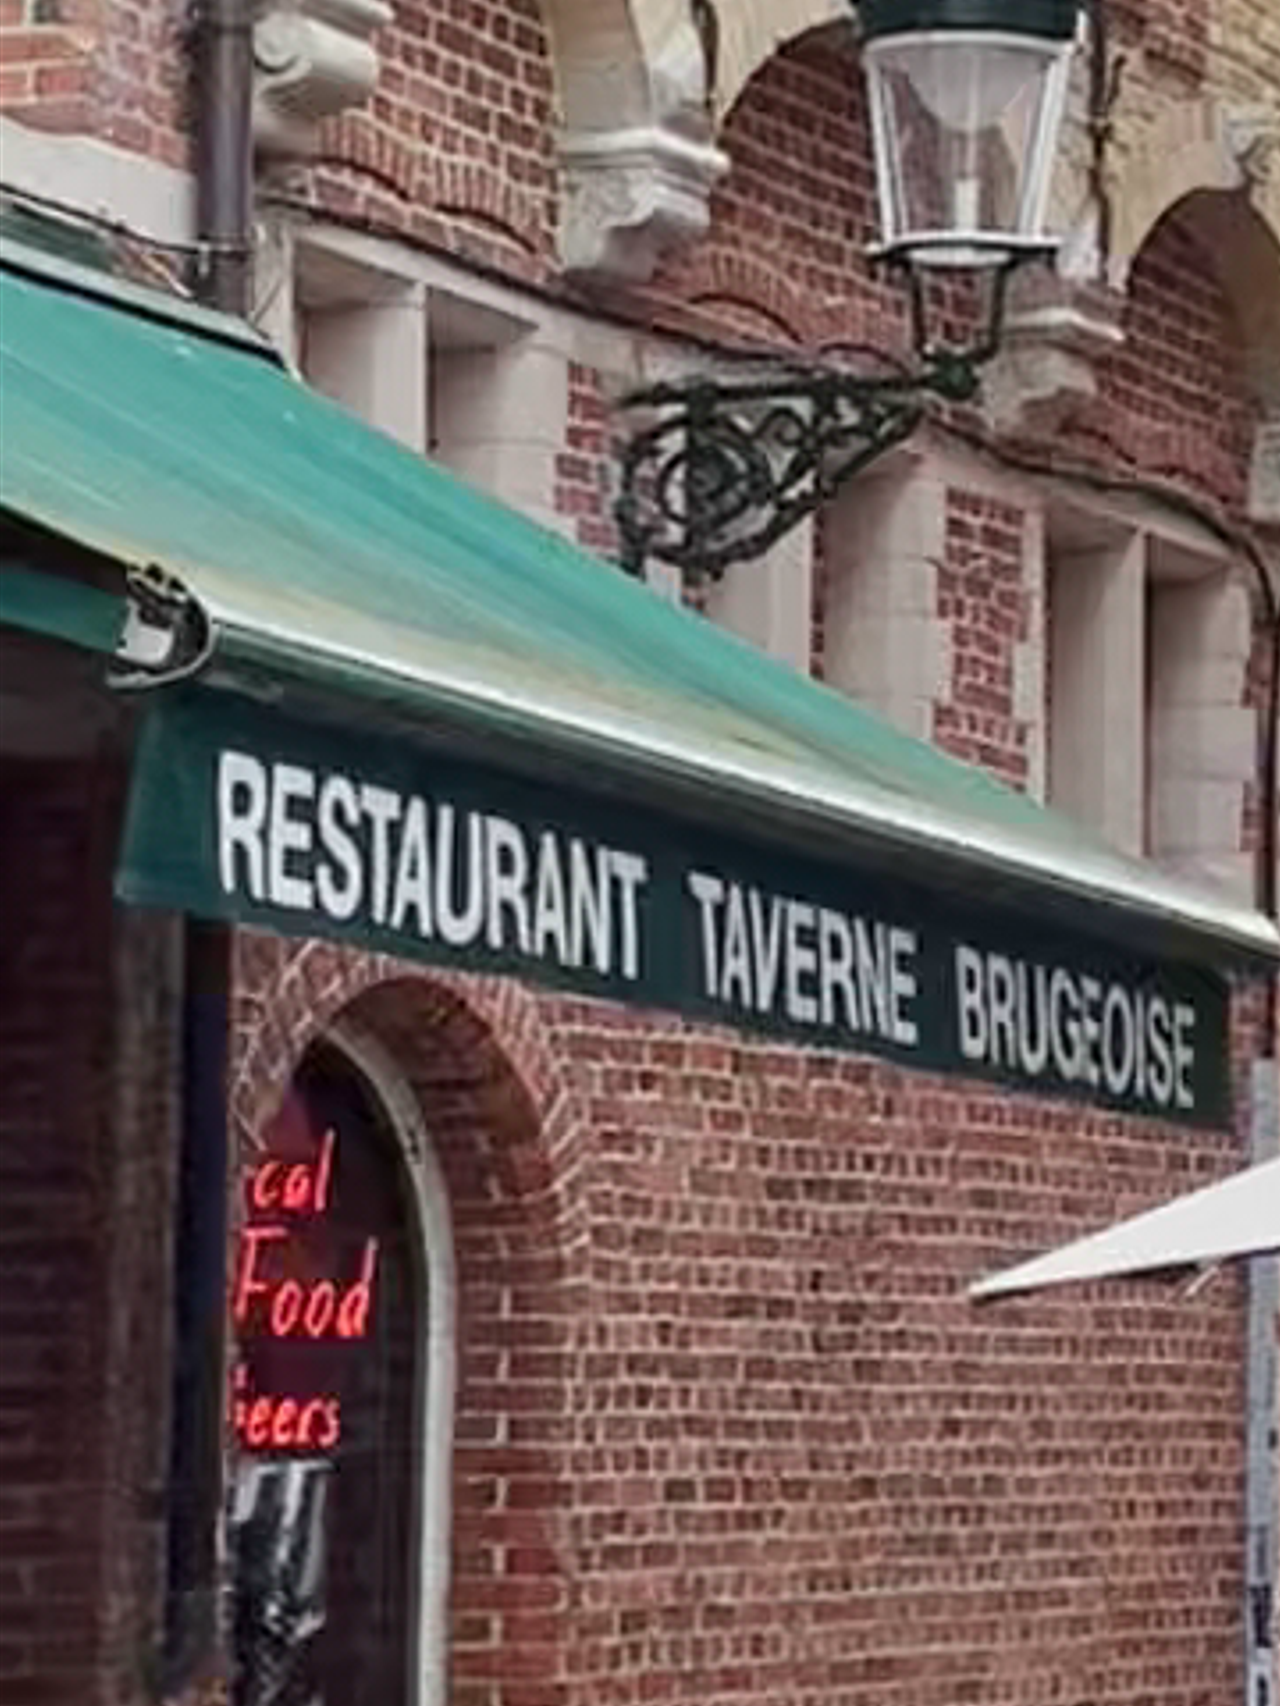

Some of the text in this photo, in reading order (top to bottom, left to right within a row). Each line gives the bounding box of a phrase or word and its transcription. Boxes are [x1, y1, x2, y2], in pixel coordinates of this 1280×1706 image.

[217, 750, 1195, 1109] RESTAURANT TAVERNE BRUGEOISE
[242, 1127, 335, 1212] cal
[234, 1226, 377, 1337] Food
